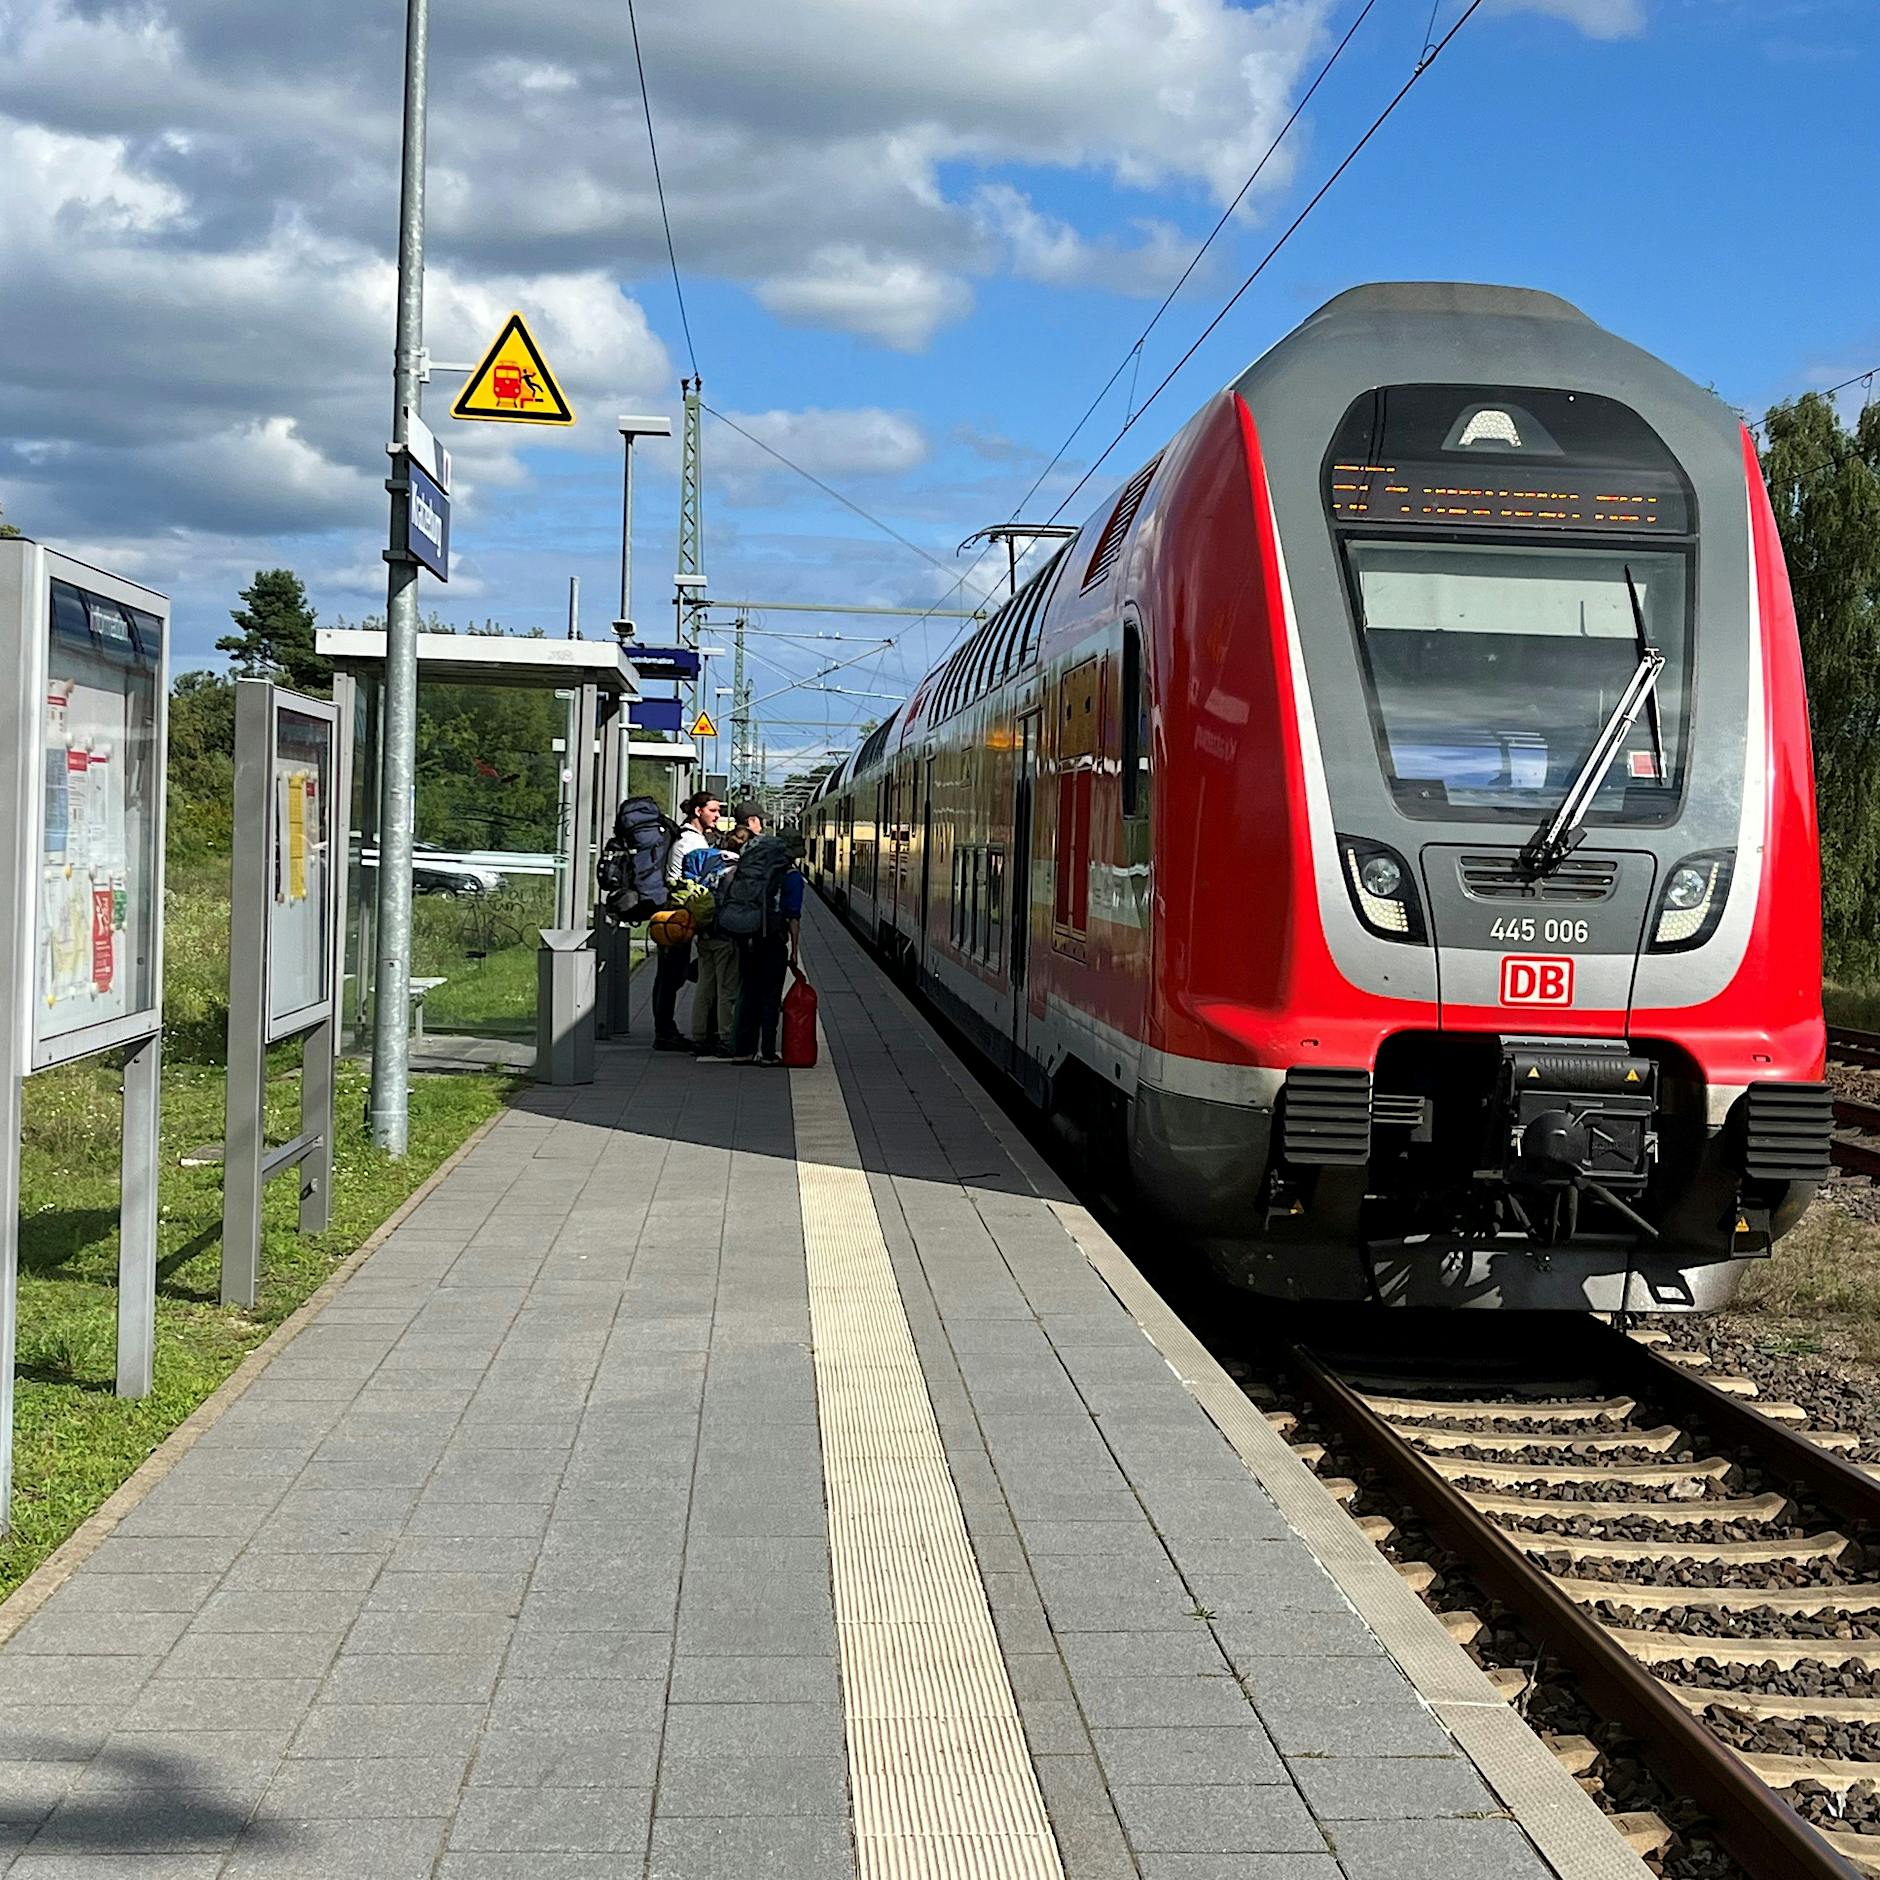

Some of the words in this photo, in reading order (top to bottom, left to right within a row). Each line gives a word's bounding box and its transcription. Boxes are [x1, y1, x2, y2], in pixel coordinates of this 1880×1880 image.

[1490, 917, 1536, 941] 445
[1544, 918, 1589, 943] 006
[1508, 963, 1566, 1000] DB
